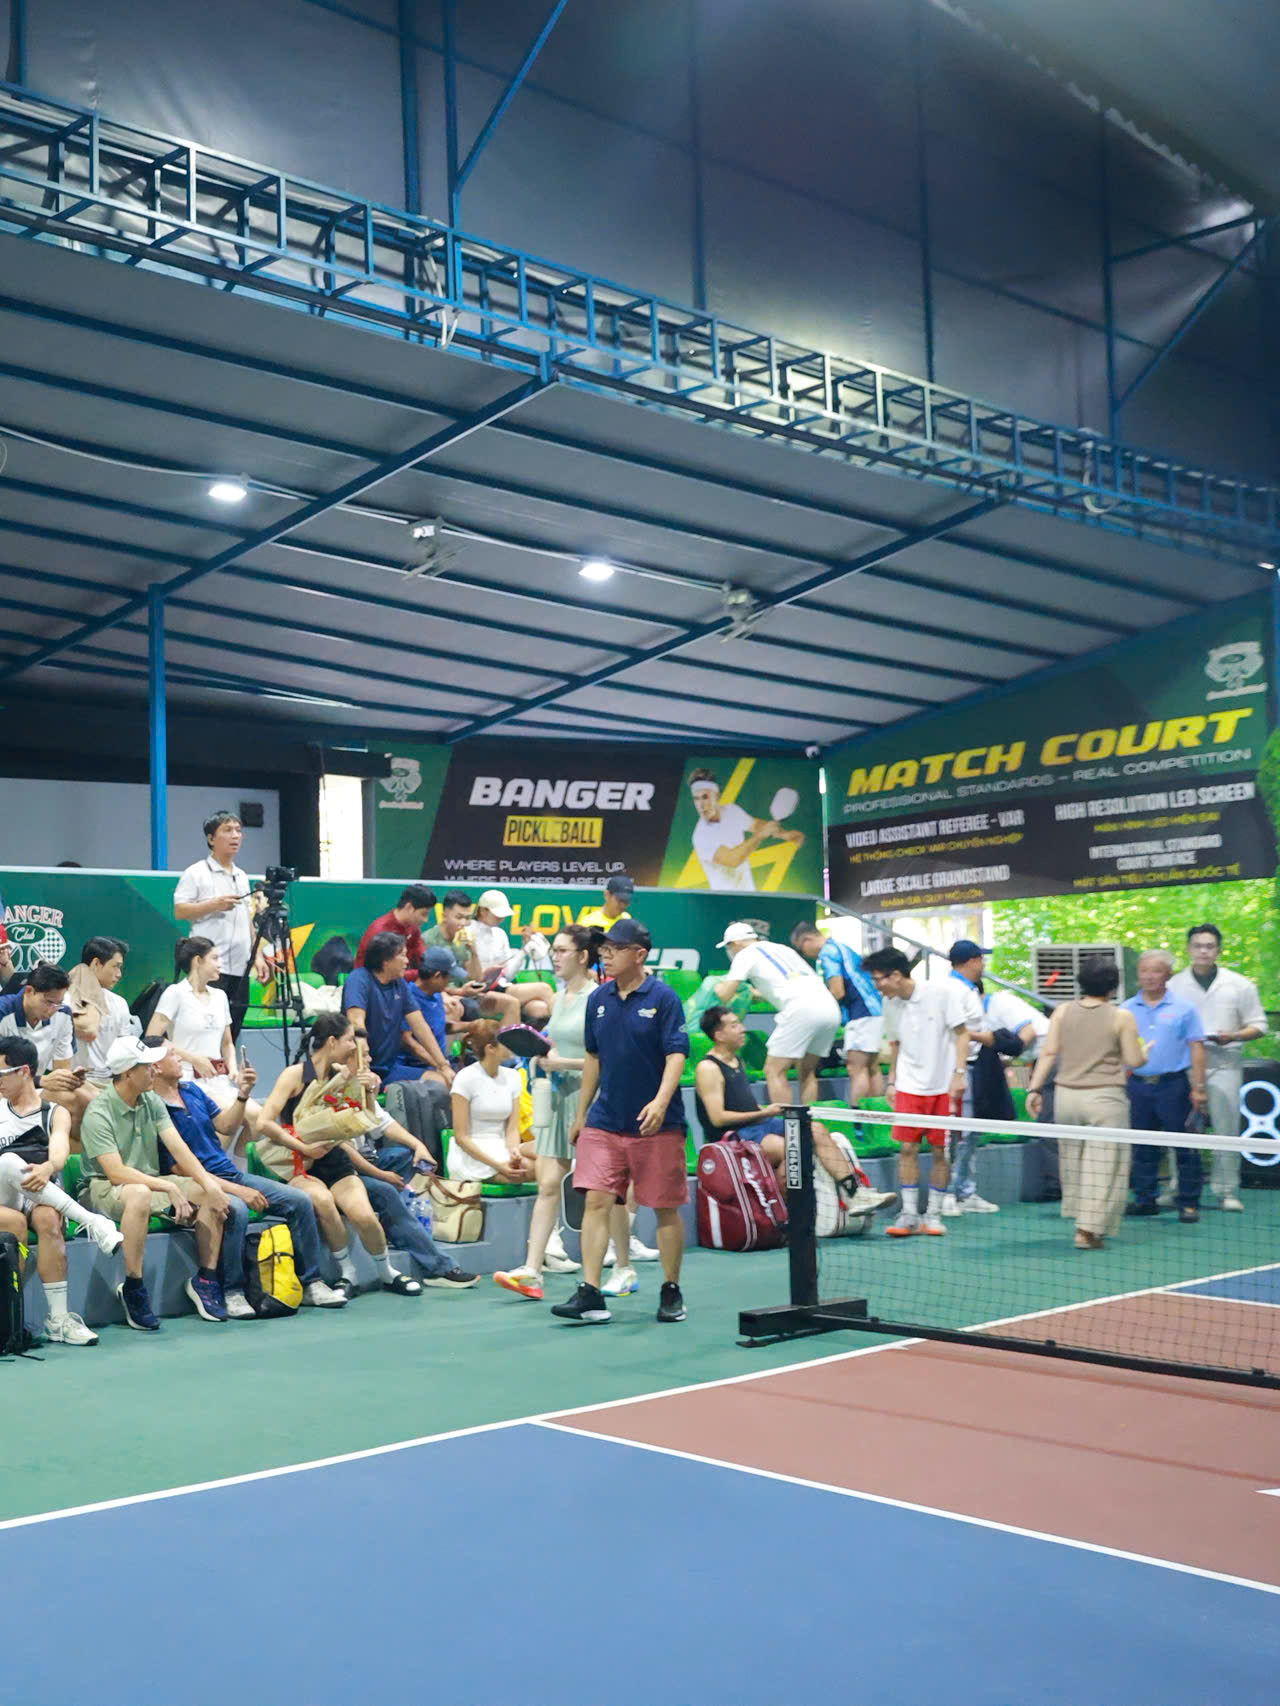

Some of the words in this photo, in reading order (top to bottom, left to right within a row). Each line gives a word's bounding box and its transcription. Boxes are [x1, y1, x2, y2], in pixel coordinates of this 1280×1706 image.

[847, 741, 1026, 796] MATCH
[1040, 707, 1253, 766] COURT
[469, 776, 656, 810] BANGER
[844, 789, 952, 814] PROFESSIONAL
[957, 774, 1055, 797] STANDARDS
[1073, 766, 1120, 781] REAL
[1123, 747, 1252, 776] COMPETITION
[1054, 801, 1087, 821] HIGH
[1087, 792, 1169, 817] RESOLUTION
[1169, 788, 1197, 809] LED
[1198, 781, 1256, 805] SCREEN
[508, 818, 597, 844] PICKLEBALL
[846, 829, 878, 848] VIDEO
[878, 820, 937, 843] ASSISTANT
[938, 813, 991, 835] REFEREE
[998, 809, 1025, 828] VAR
[444, 859, 496, 871] WHERE
[499, 860, 561, 872] PLAYERS
[563, 861, 603, 872] LEVEL
[861, 877, 896, 897] LARGE
[11, 926, 39, 942] Club
[510, 903, 604, 936] LOV
